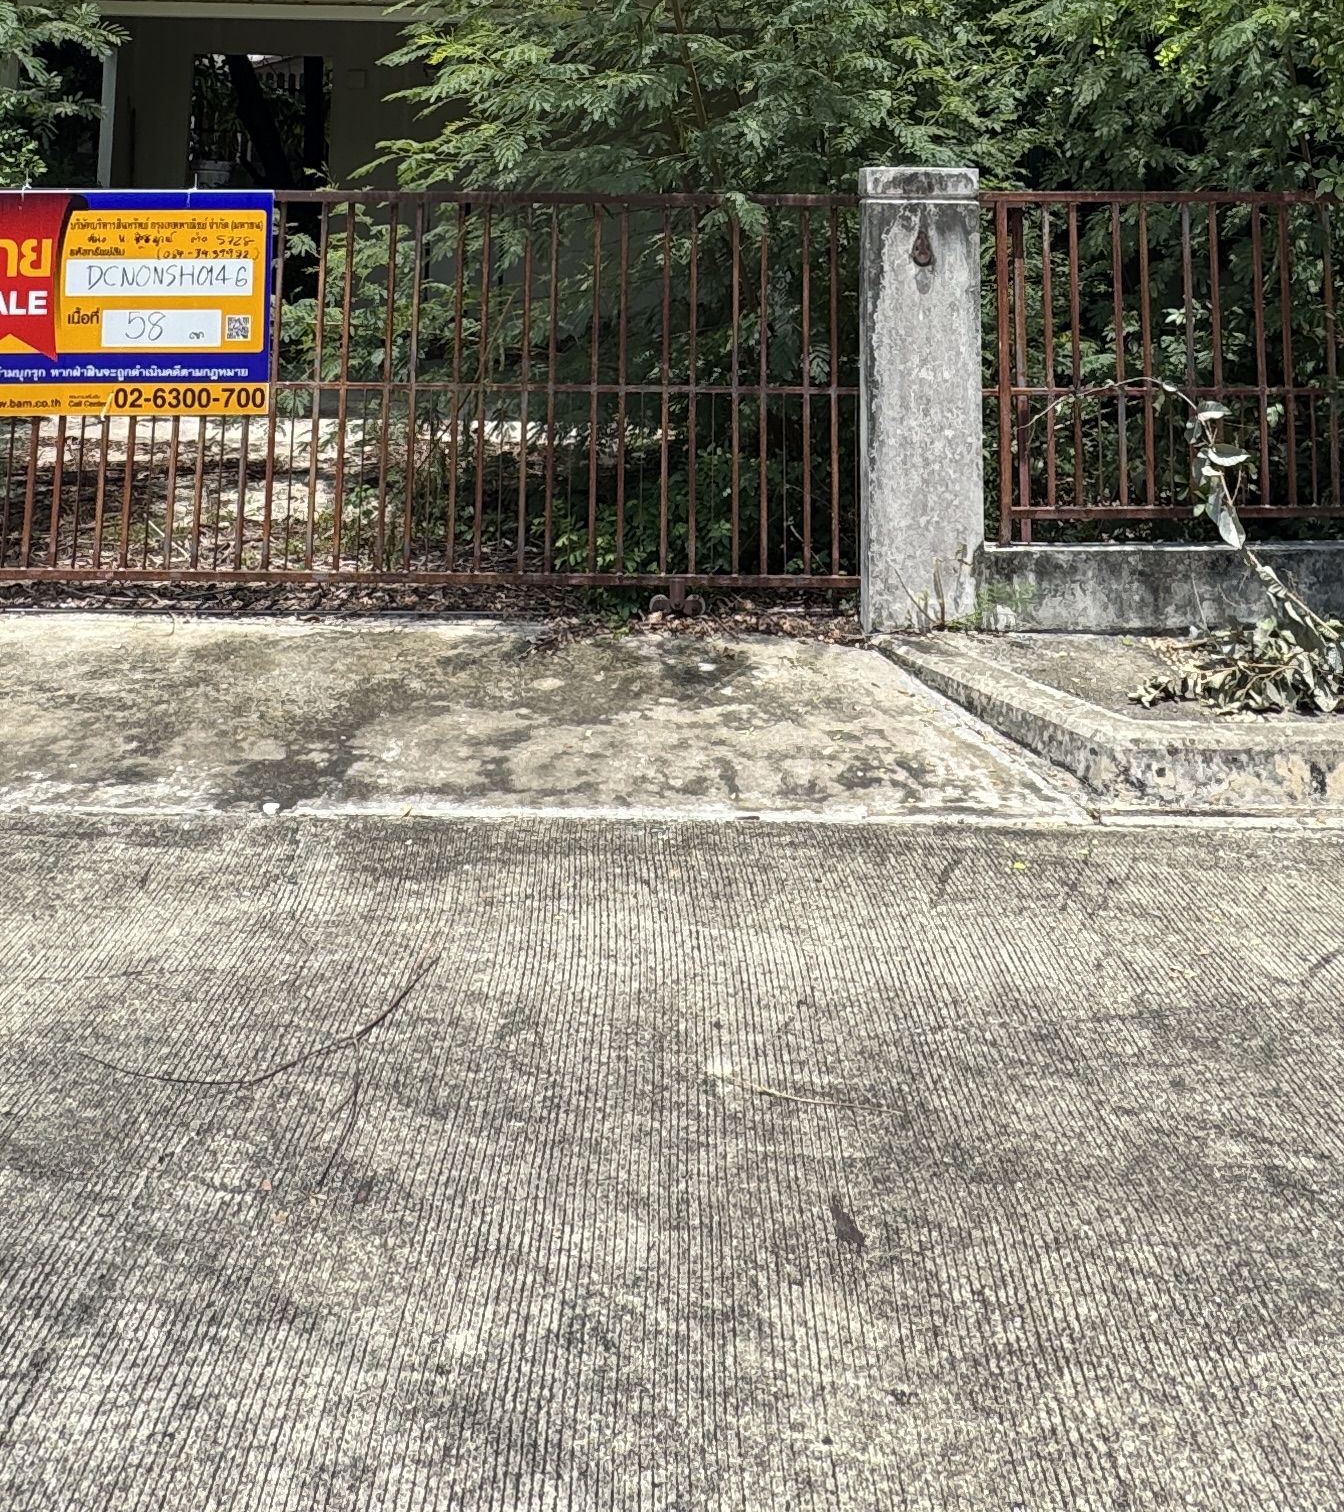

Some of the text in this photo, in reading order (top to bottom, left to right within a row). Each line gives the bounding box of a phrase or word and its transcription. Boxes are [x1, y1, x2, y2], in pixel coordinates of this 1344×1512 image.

[67, 307, 100, 325] เนื้อที่
[125, 311, 166, 341] 58
[114, 387, 266, 409] 02-6300-700
